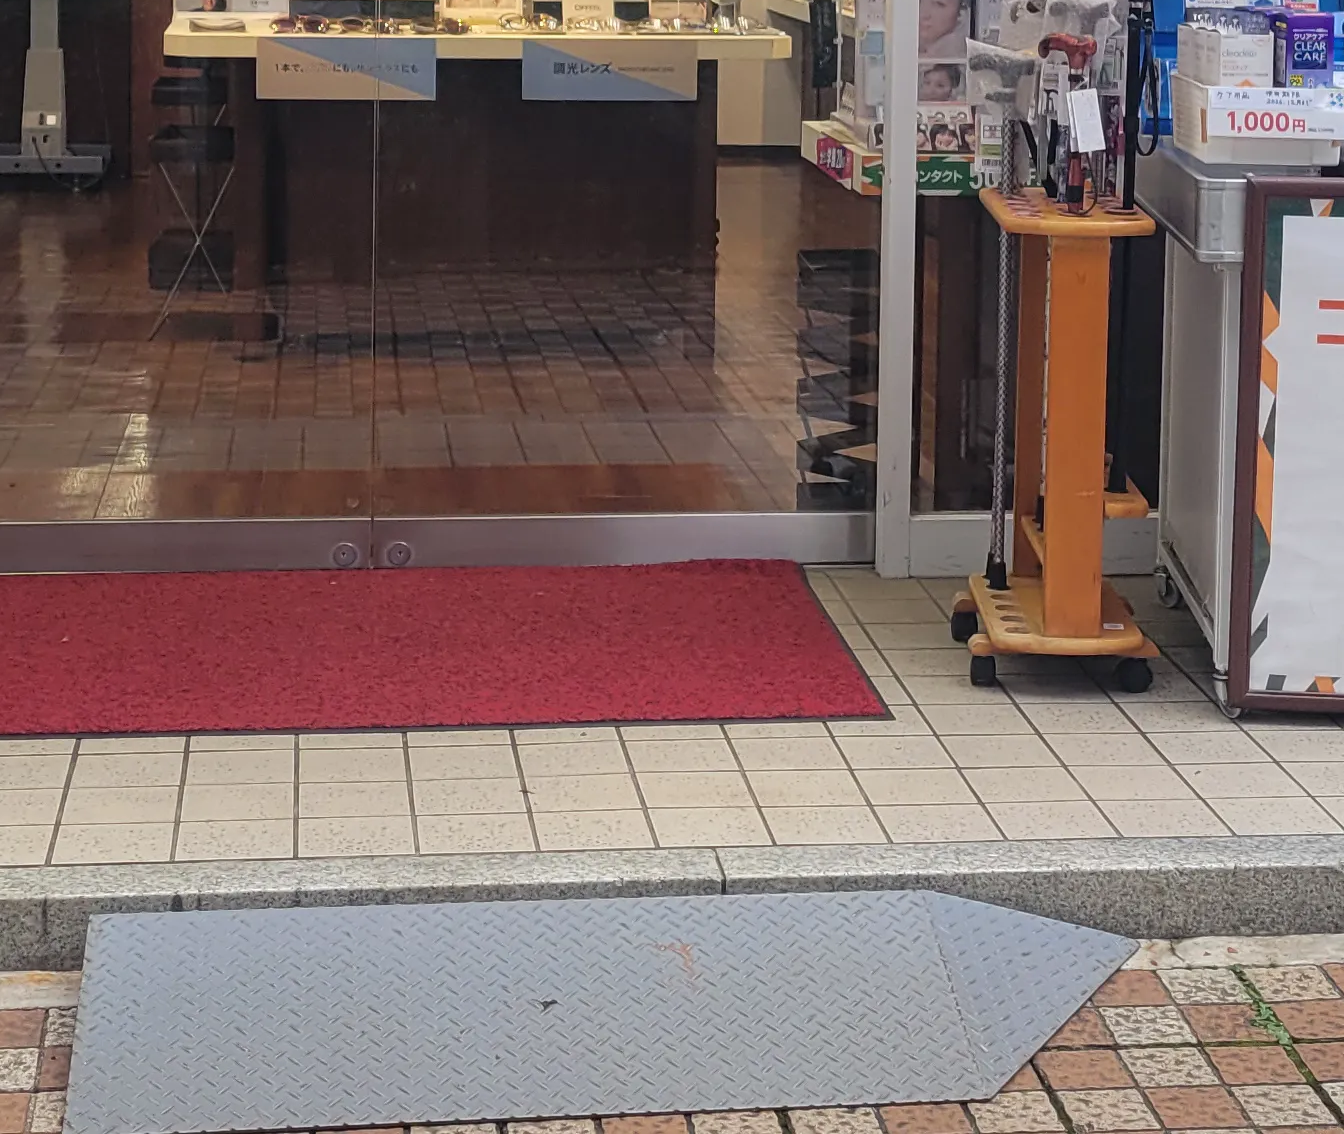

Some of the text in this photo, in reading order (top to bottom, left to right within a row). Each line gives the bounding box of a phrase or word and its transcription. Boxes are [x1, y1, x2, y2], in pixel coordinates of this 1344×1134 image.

[1294, 41, 1326, 52] CLEAR
[1293, 52, 1326, 63] CARE
[1226, 111, 1306, 134] 1,000円
[916, 169, 964, 184] ンタクト
